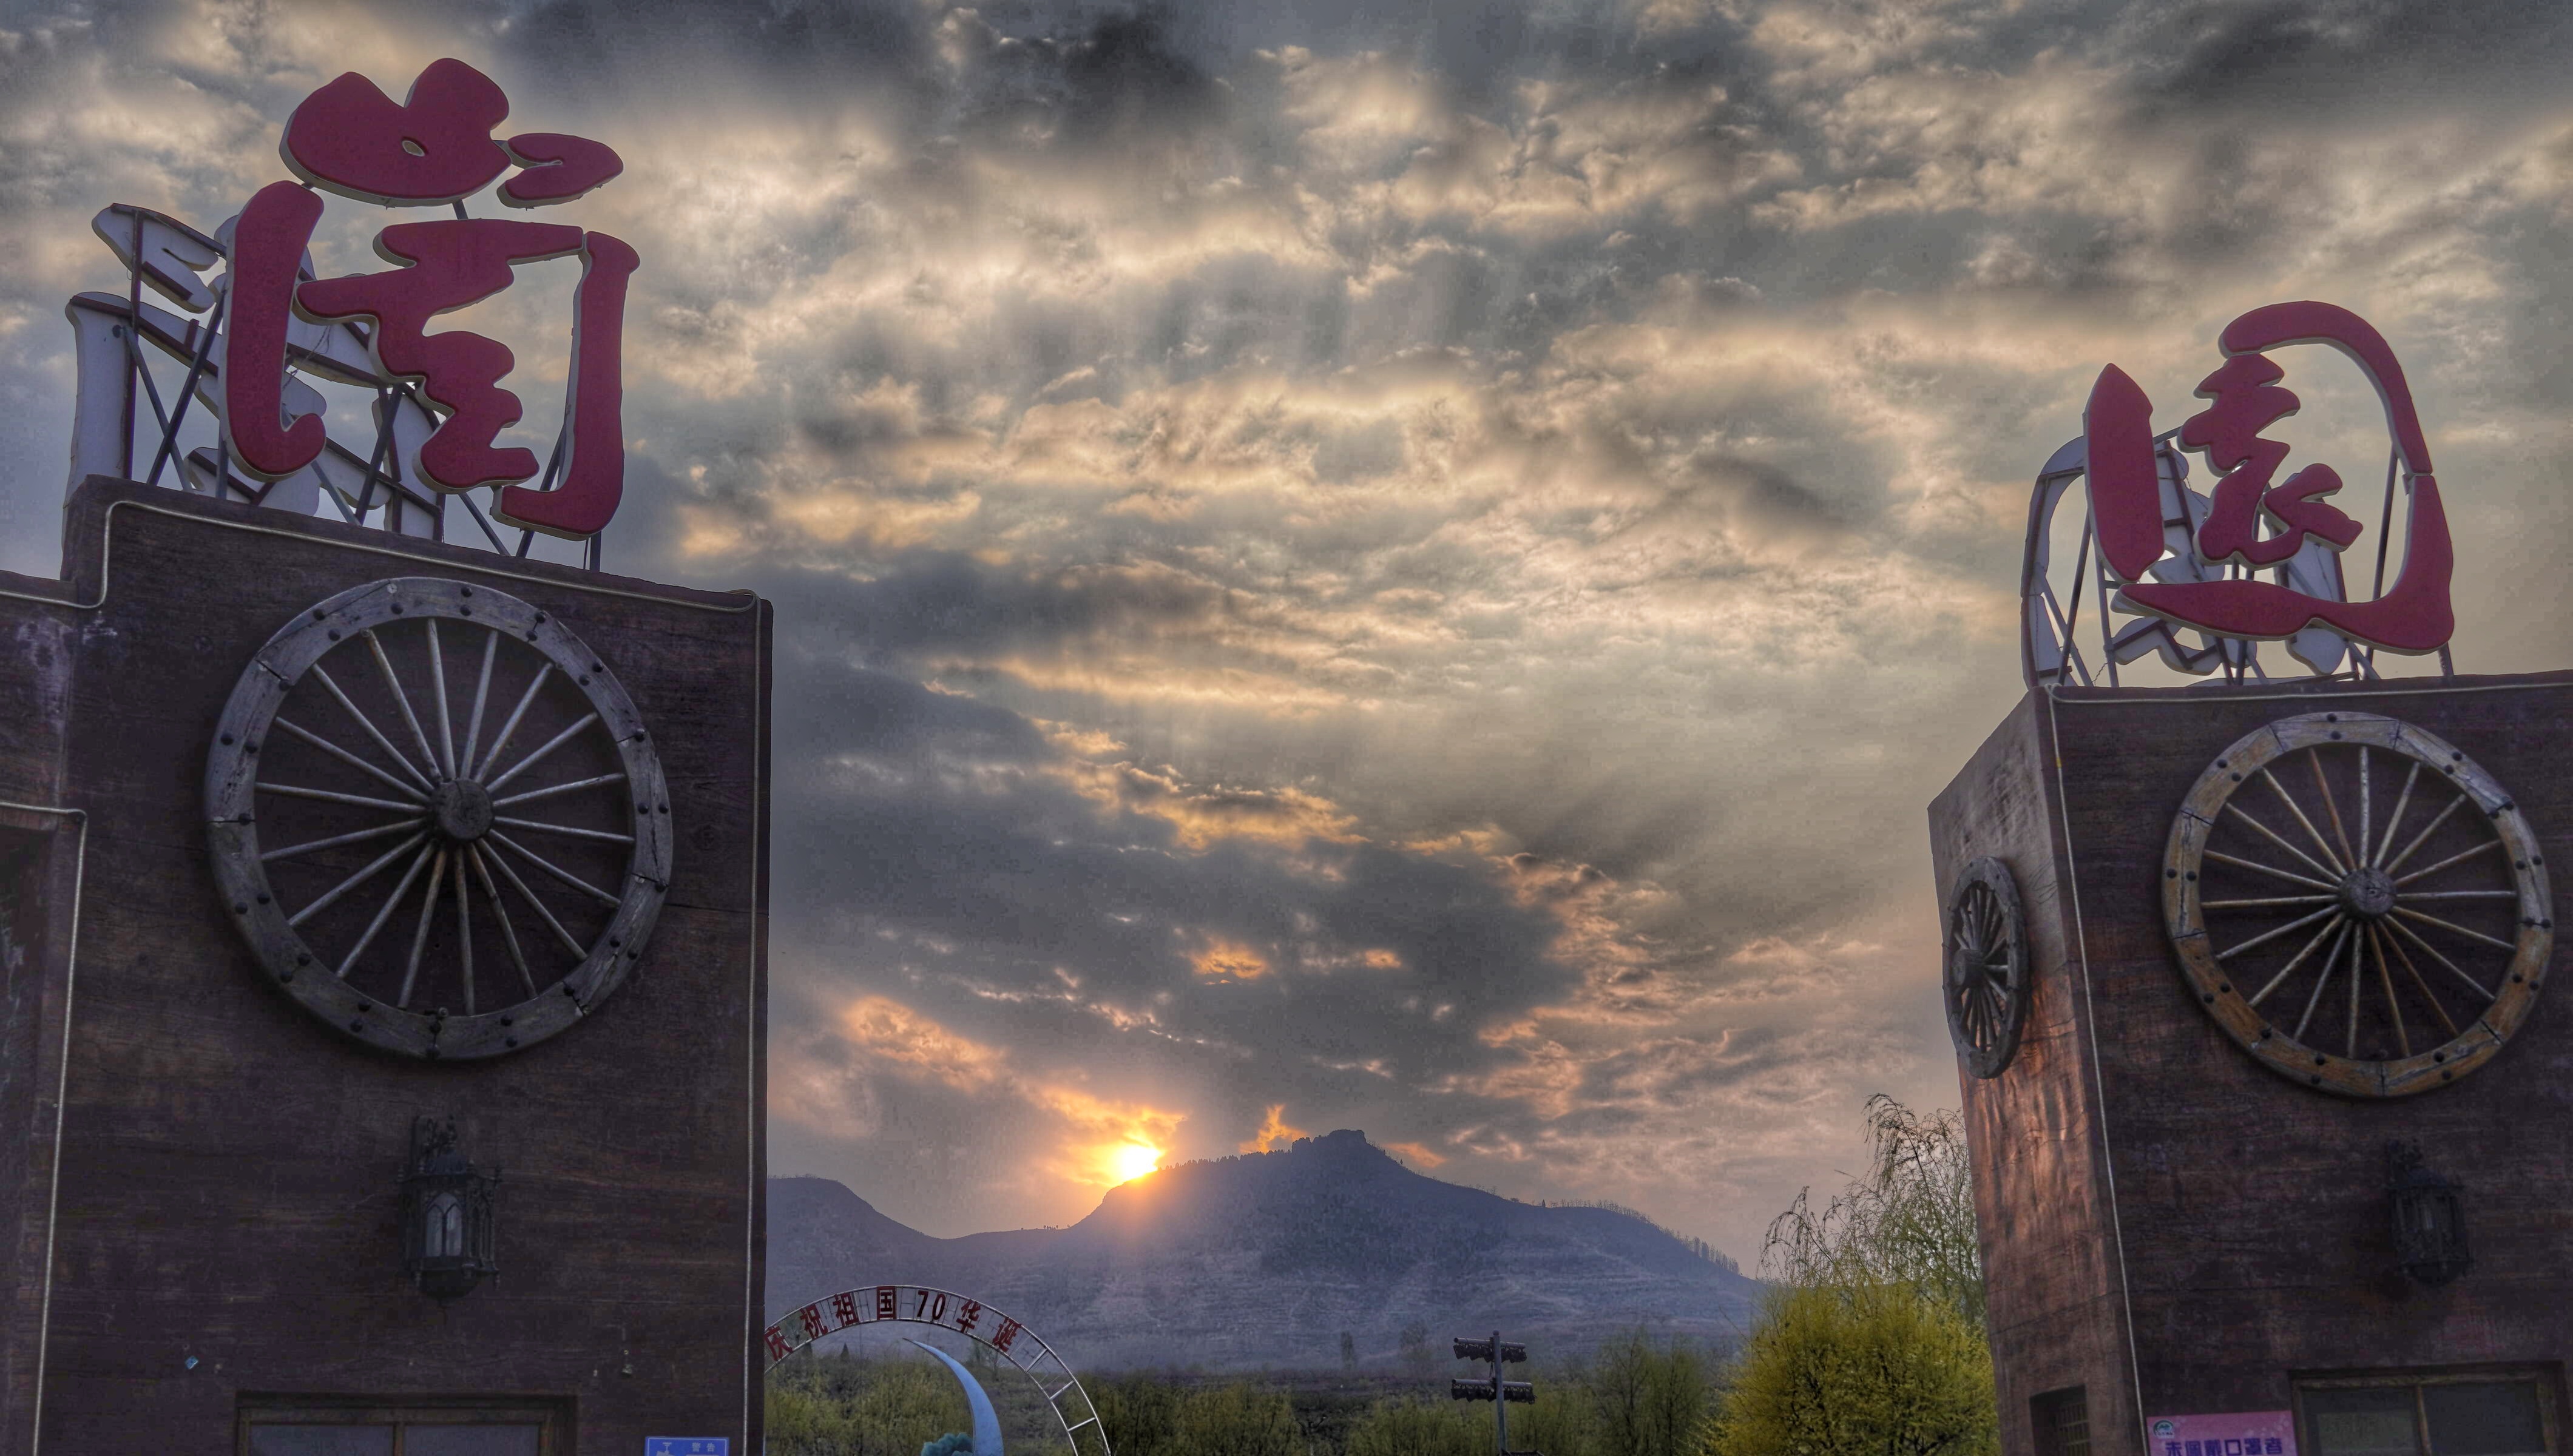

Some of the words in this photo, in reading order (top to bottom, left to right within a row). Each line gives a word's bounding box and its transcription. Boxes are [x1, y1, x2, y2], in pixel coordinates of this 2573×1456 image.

[764, 1286, 1022, 1361] 庆祝祖国70华诞
[692, 1442, 715, 1452] 警告
[2165, 1437, 2283, 1456] 未佩戴口罩者
